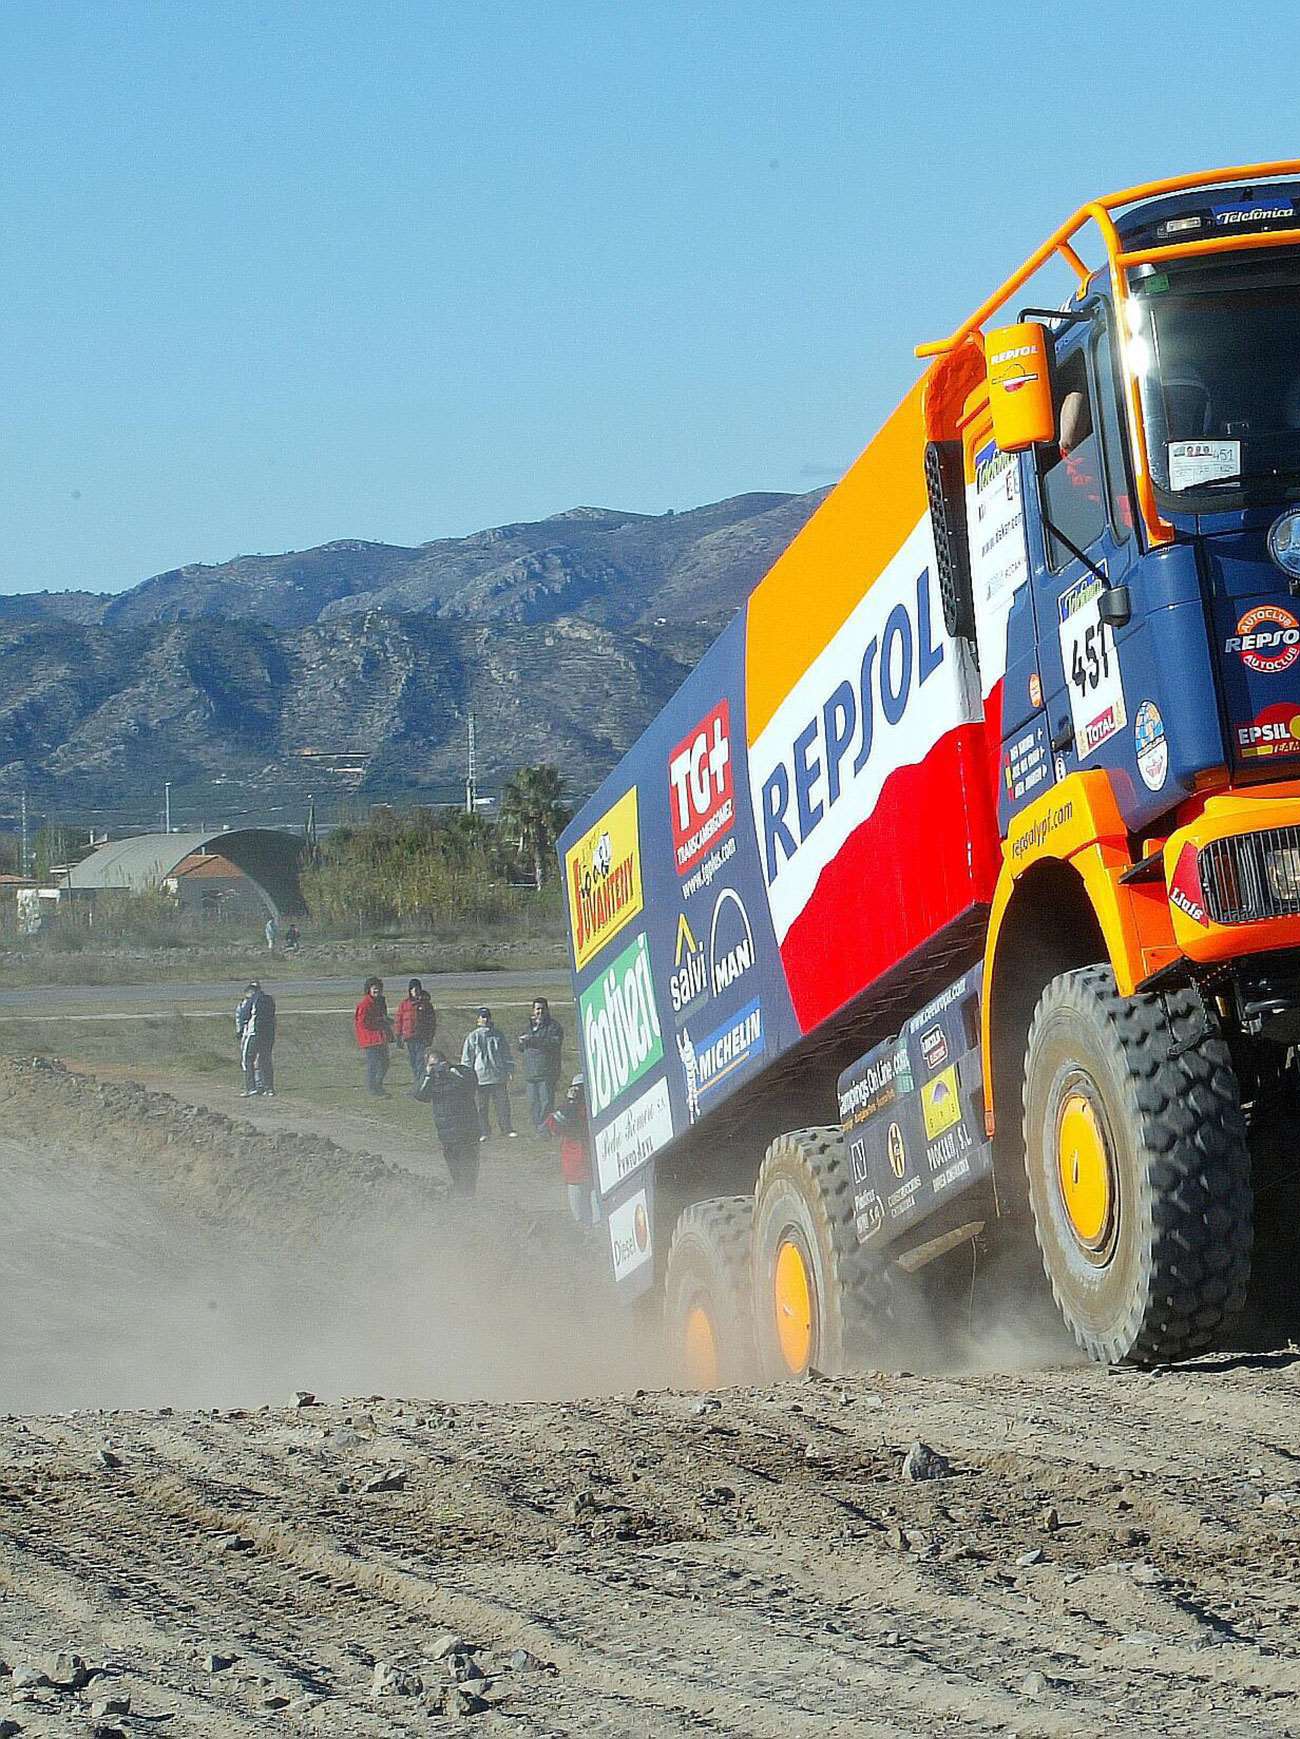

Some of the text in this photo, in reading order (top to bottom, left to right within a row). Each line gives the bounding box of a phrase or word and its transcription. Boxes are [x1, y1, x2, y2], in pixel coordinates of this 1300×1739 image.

[1216, 207, 1295, 225] Telefónica
[991, 345, 1040, 366] REPSOL
[1242, 608, 1293, 635] AUTOCLUB
[1071, 618, 1109, 698] 451
[1243, 646, 1299, 670] AUTOCLUB
[762, 565, 944, 888] REPSOL
[1087, 714, 1116, 744] TOTAL
[670, 716, 729, 832] TG+
[714, 938, 755, 994] MAN
[699, 1007, 762, 1083] MICHELIN
